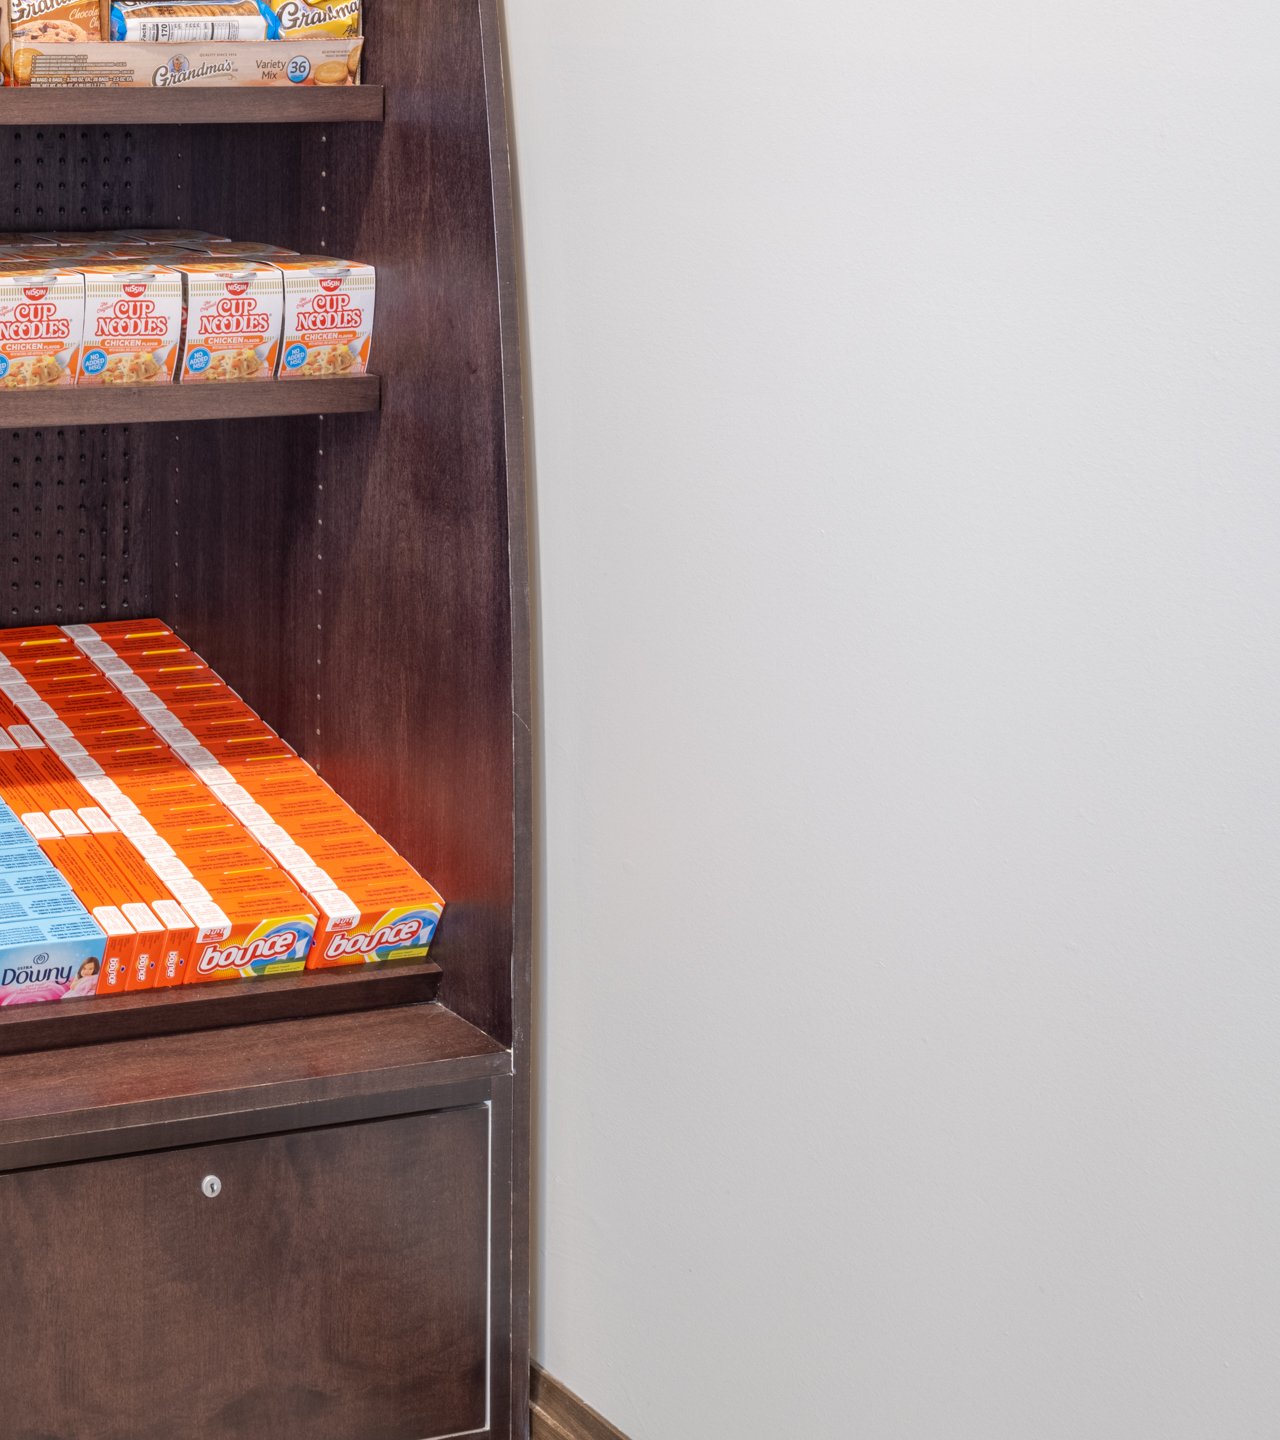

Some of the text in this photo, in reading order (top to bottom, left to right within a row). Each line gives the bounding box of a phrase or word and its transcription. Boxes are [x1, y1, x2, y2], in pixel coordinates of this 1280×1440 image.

[151, 60, 234, 87] Grandma's
[256, 59, 287, 72] Variety
[261, 71, 278, 80] Mix
[291, 61, 307, 72] 36
[312, 294, 350, 312] CUP
[296, 309, 361, 331] NOODLES
[324, 919, 423, 958] bounce
[197, 933, 297, 975] bounce
[1, 964, 73, 986] Downy
